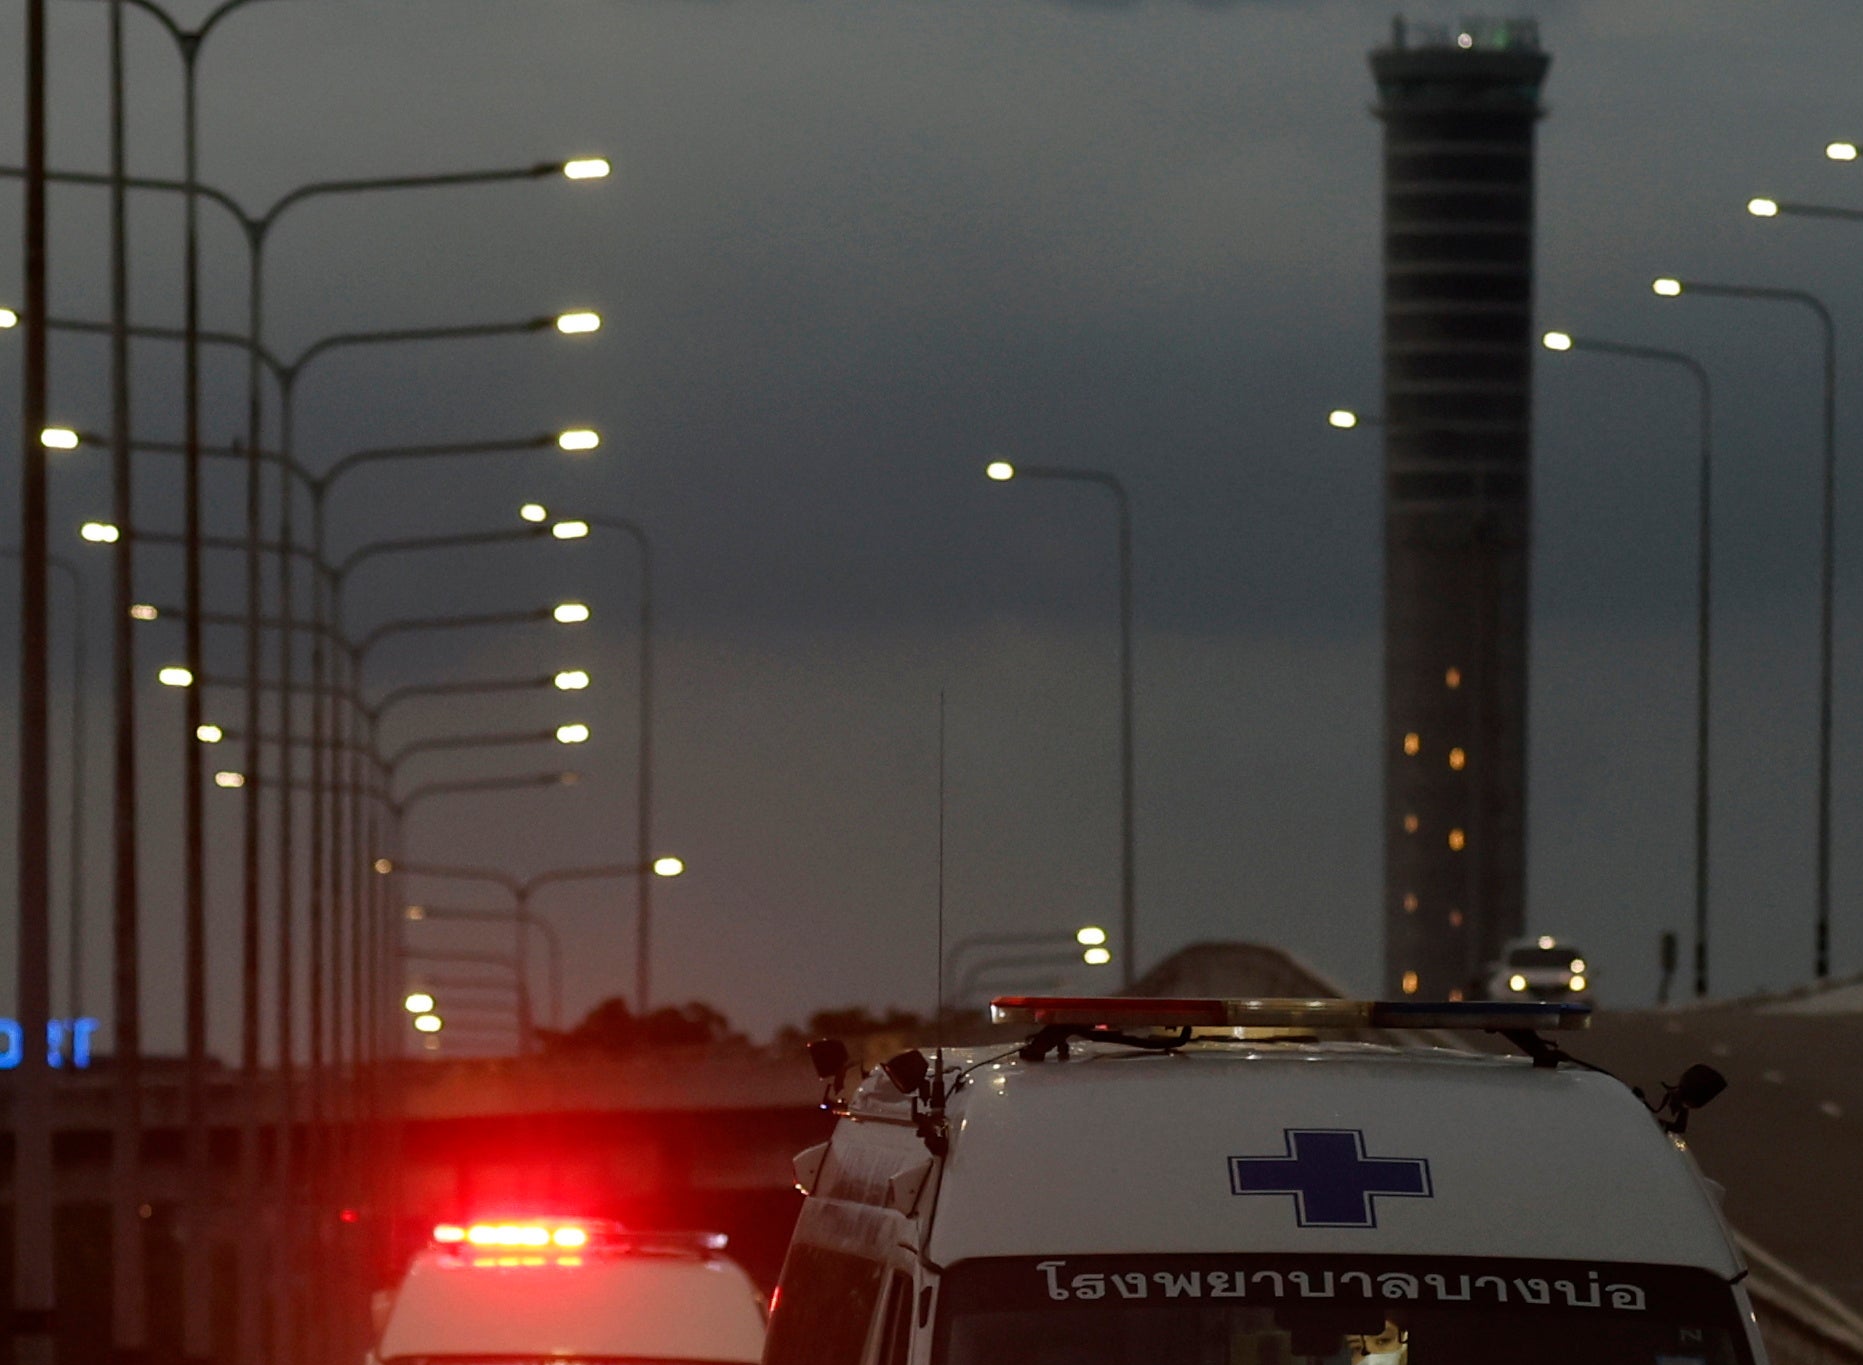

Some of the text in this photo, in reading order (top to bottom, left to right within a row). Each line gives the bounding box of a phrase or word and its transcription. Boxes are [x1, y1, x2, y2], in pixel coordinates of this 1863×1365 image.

[1036, 1260, 1647, 1311] โรงพยาบาลบางบ่อ
